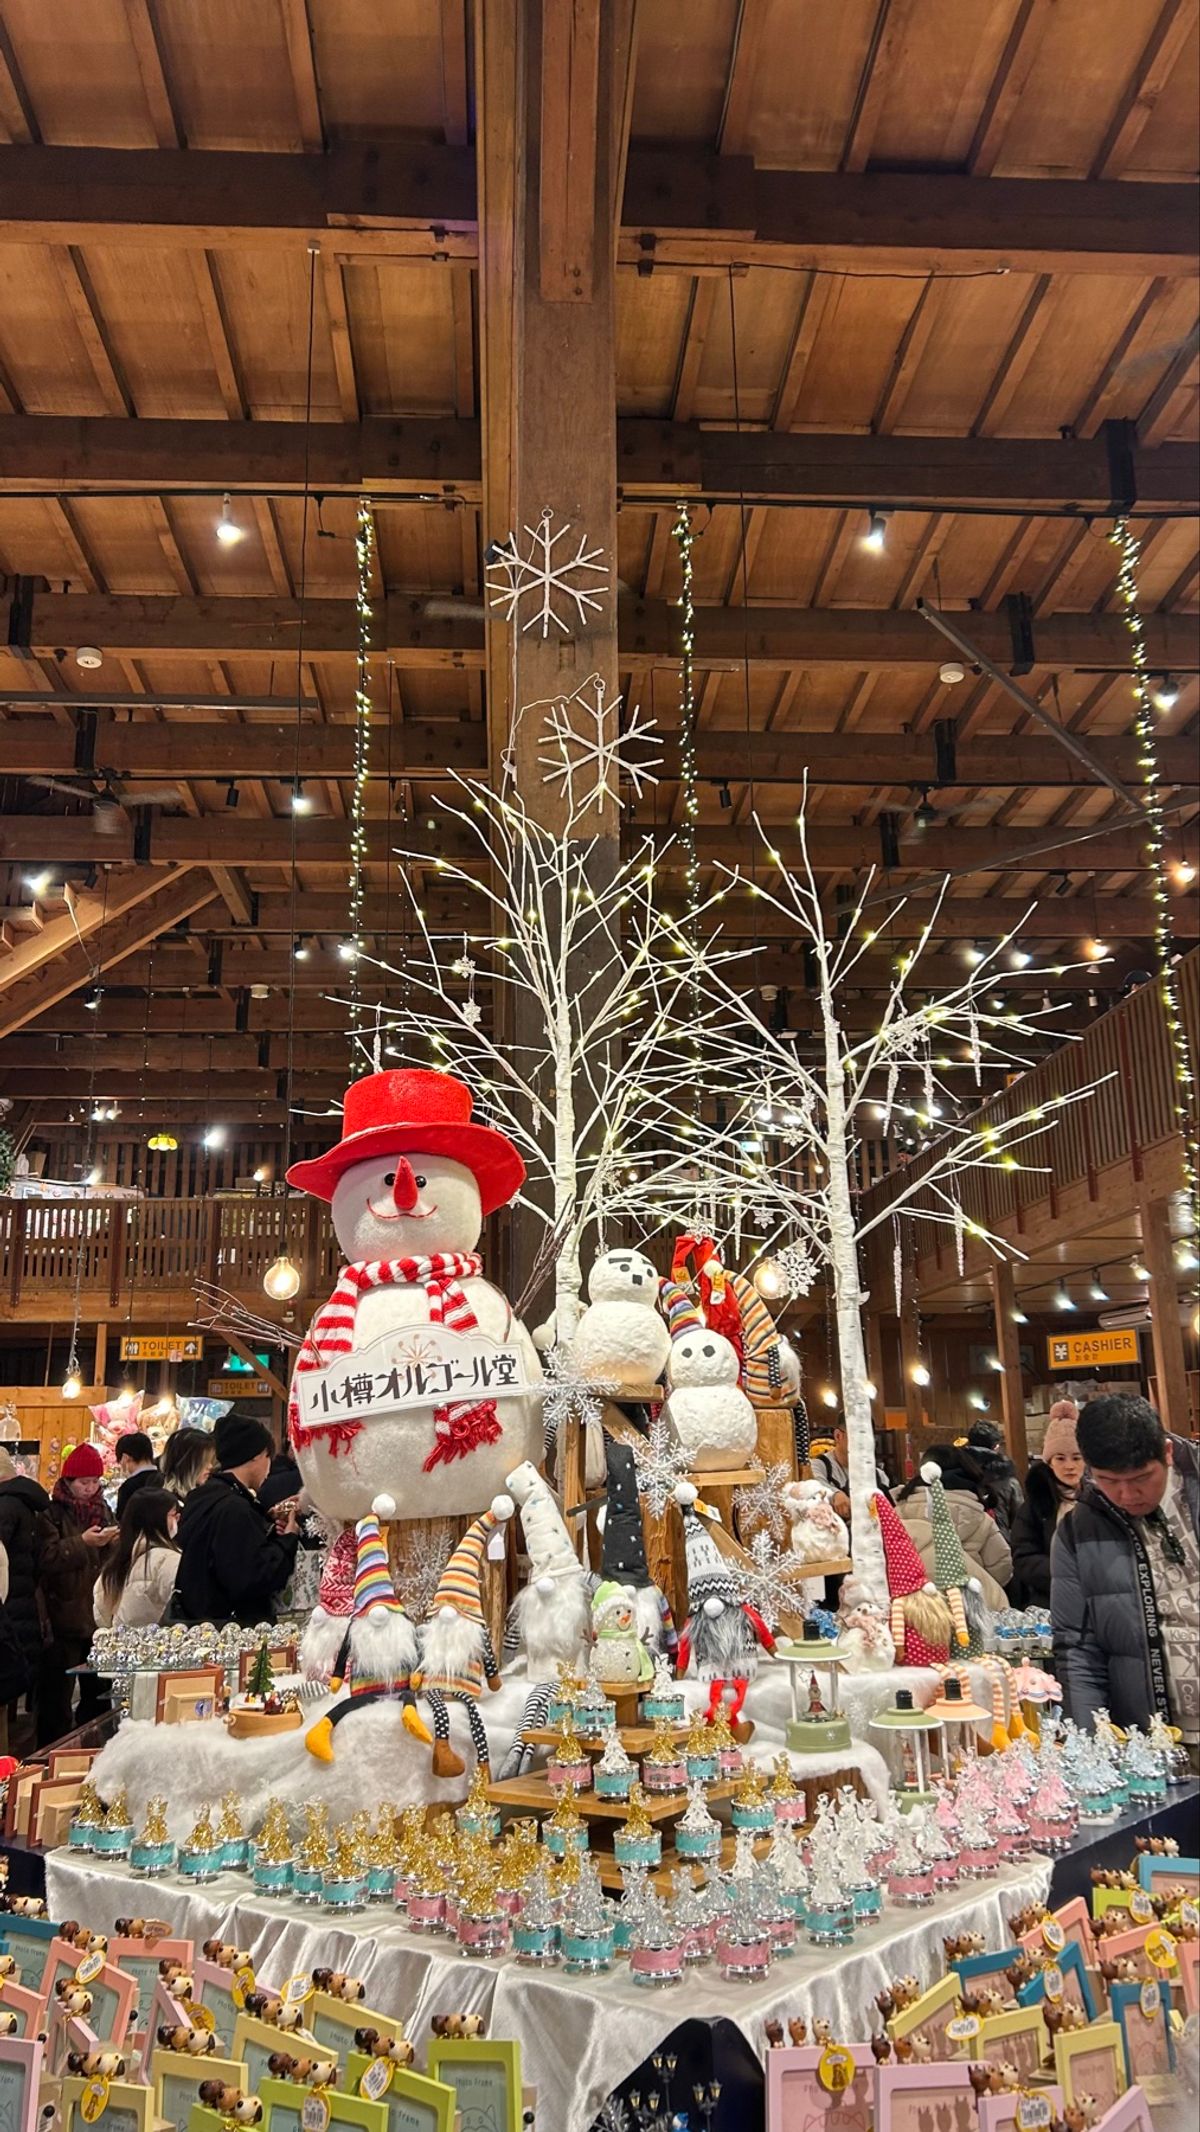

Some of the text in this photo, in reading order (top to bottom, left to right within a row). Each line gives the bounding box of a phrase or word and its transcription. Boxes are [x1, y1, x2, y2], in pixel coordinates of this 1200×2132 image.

[142, 1341, 182, 1350] TOILET
[1073, 1337, 1132, 1353] CASHIER
[310, 1354, 519, 1412] 小樽オルゴール堂
[1138, 1563, 1158, 1637] EXPLORING
[1150, 1648, 1164, 1693] NEVER
[1156, 1697, 1170, 1723] STO
